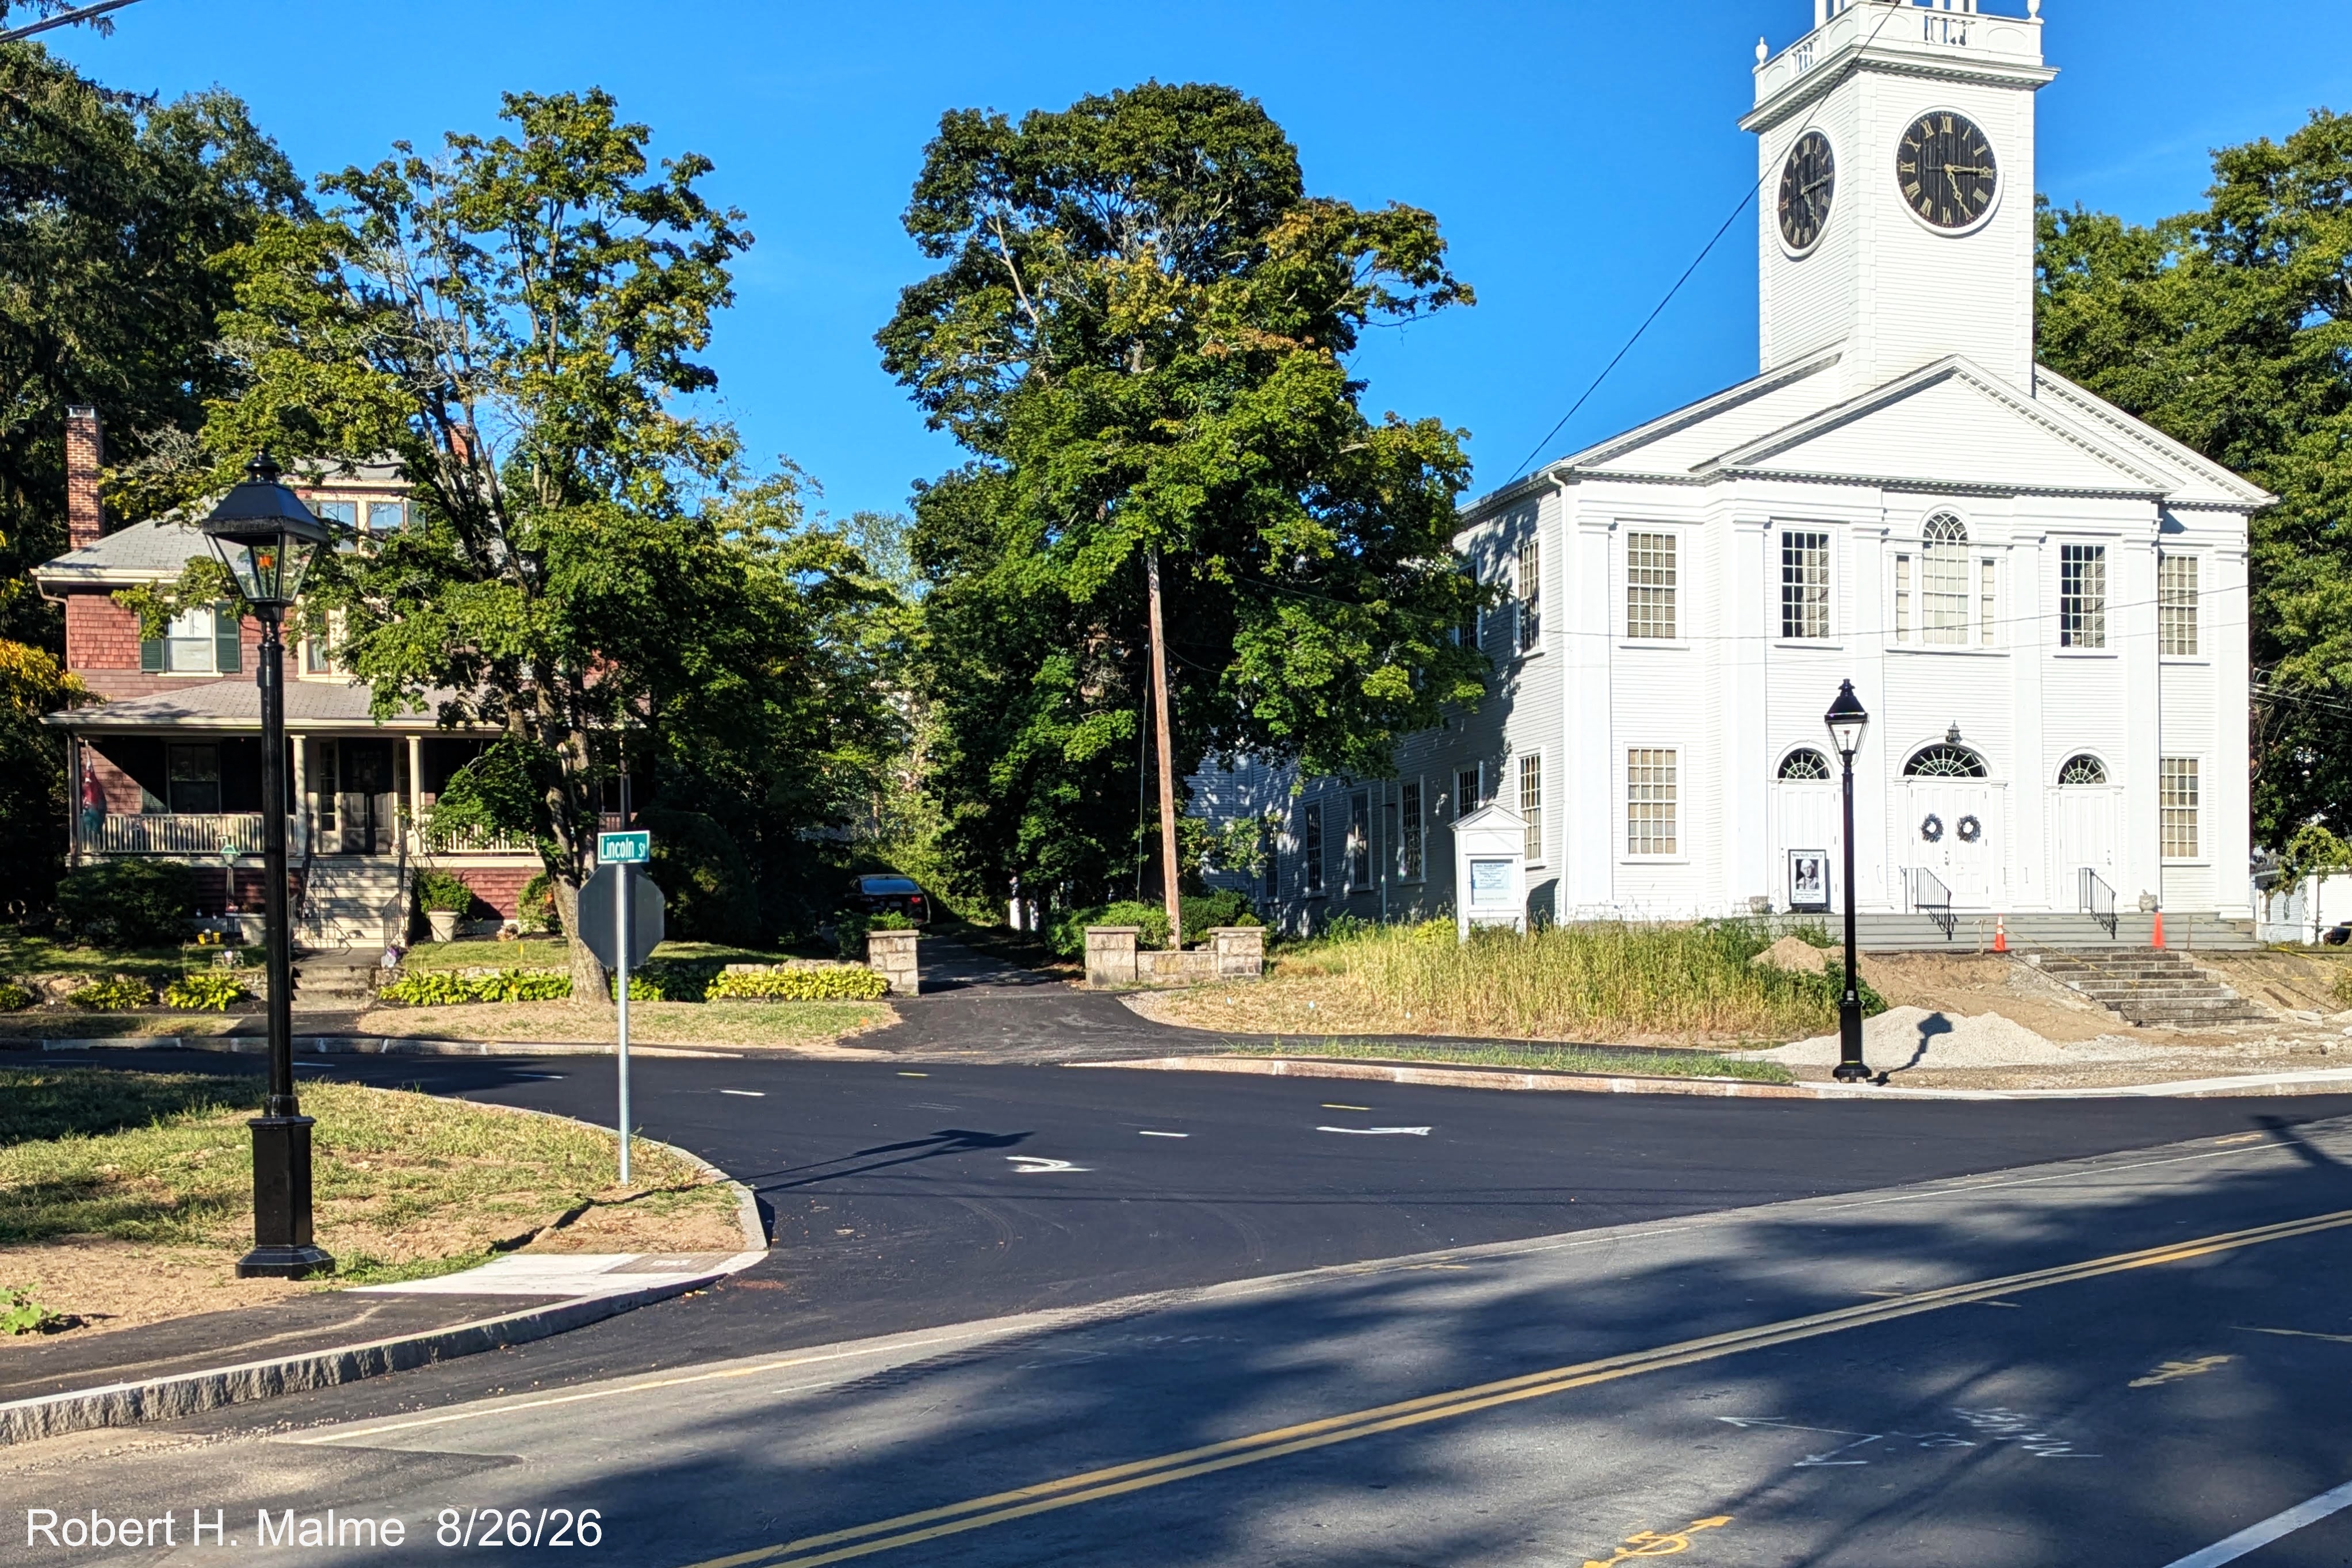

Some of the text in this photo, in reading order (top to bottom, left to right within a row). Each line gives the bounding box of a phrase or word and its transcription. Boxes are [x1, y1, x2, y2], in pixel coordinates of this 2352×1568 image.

[1920, 120, 1934, 139] XI
[1941, 116, 1953, 133] XII
[1904, 136, 1921, 152] X
[1973, 144, 1987, 157] II
[1900, 160, 1915, 174] IX
[601, 836, 634, 859] Lincoln
